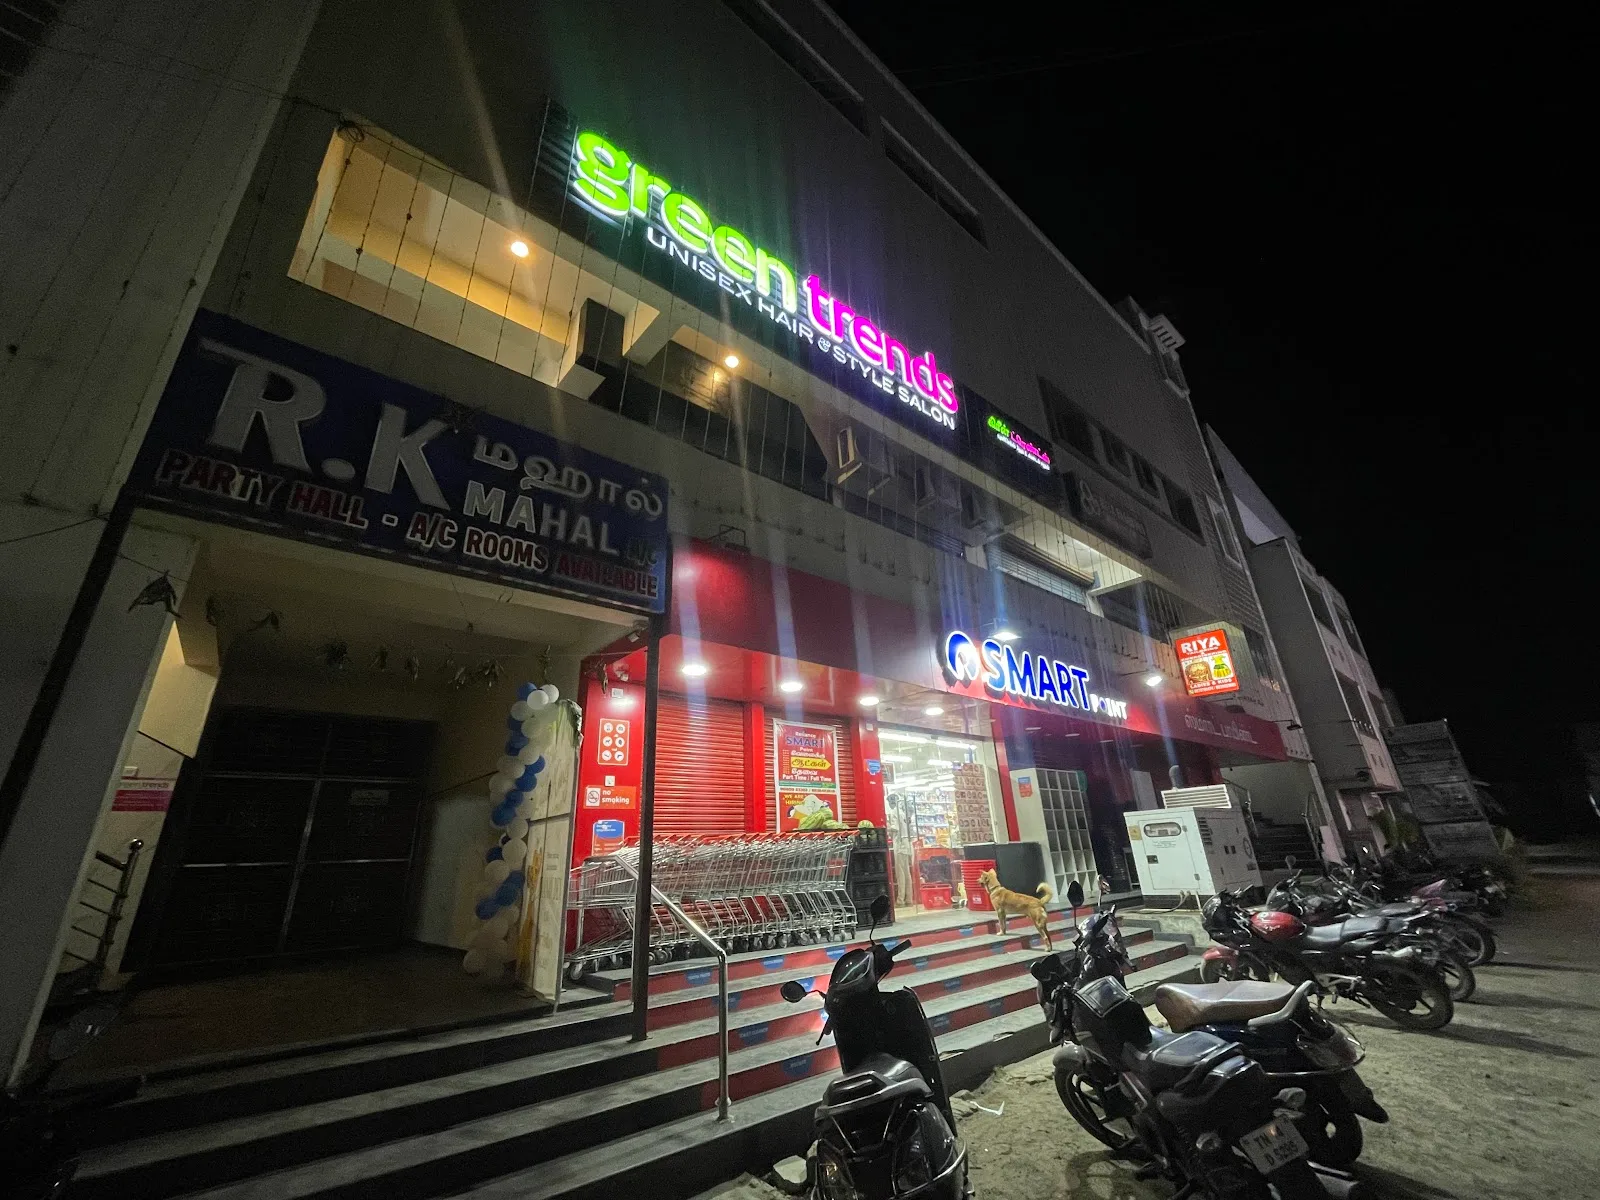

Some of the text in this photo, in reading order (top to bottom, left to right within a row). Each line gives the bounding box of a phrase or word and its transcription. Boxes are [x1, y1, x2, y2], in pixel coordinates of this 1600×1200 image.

[573, 131, 960, 414] green trends
[647, 225, 957, 431] UNISEX HAIR & STYLE SALON
[473, 433, 663, 519] மஹால்
[154, 447, 283, 506] PARTY
[288, 481, 369, 530] HALL
[406, 510, 457, 552] A/C
[463, 526, 549, 572] ROOMS
[554, 554, 659, 600] AVAILABLE
[464, 479, 620, 556] MAHAL
[981, 639, 1090, 710] SMART
[1181, 636, 1220, 654] RIYA
[786, 737, 824, 748] SMART
[1090, 693, 1127, 720] POINT
[602, 796, 629, 805] smoking
